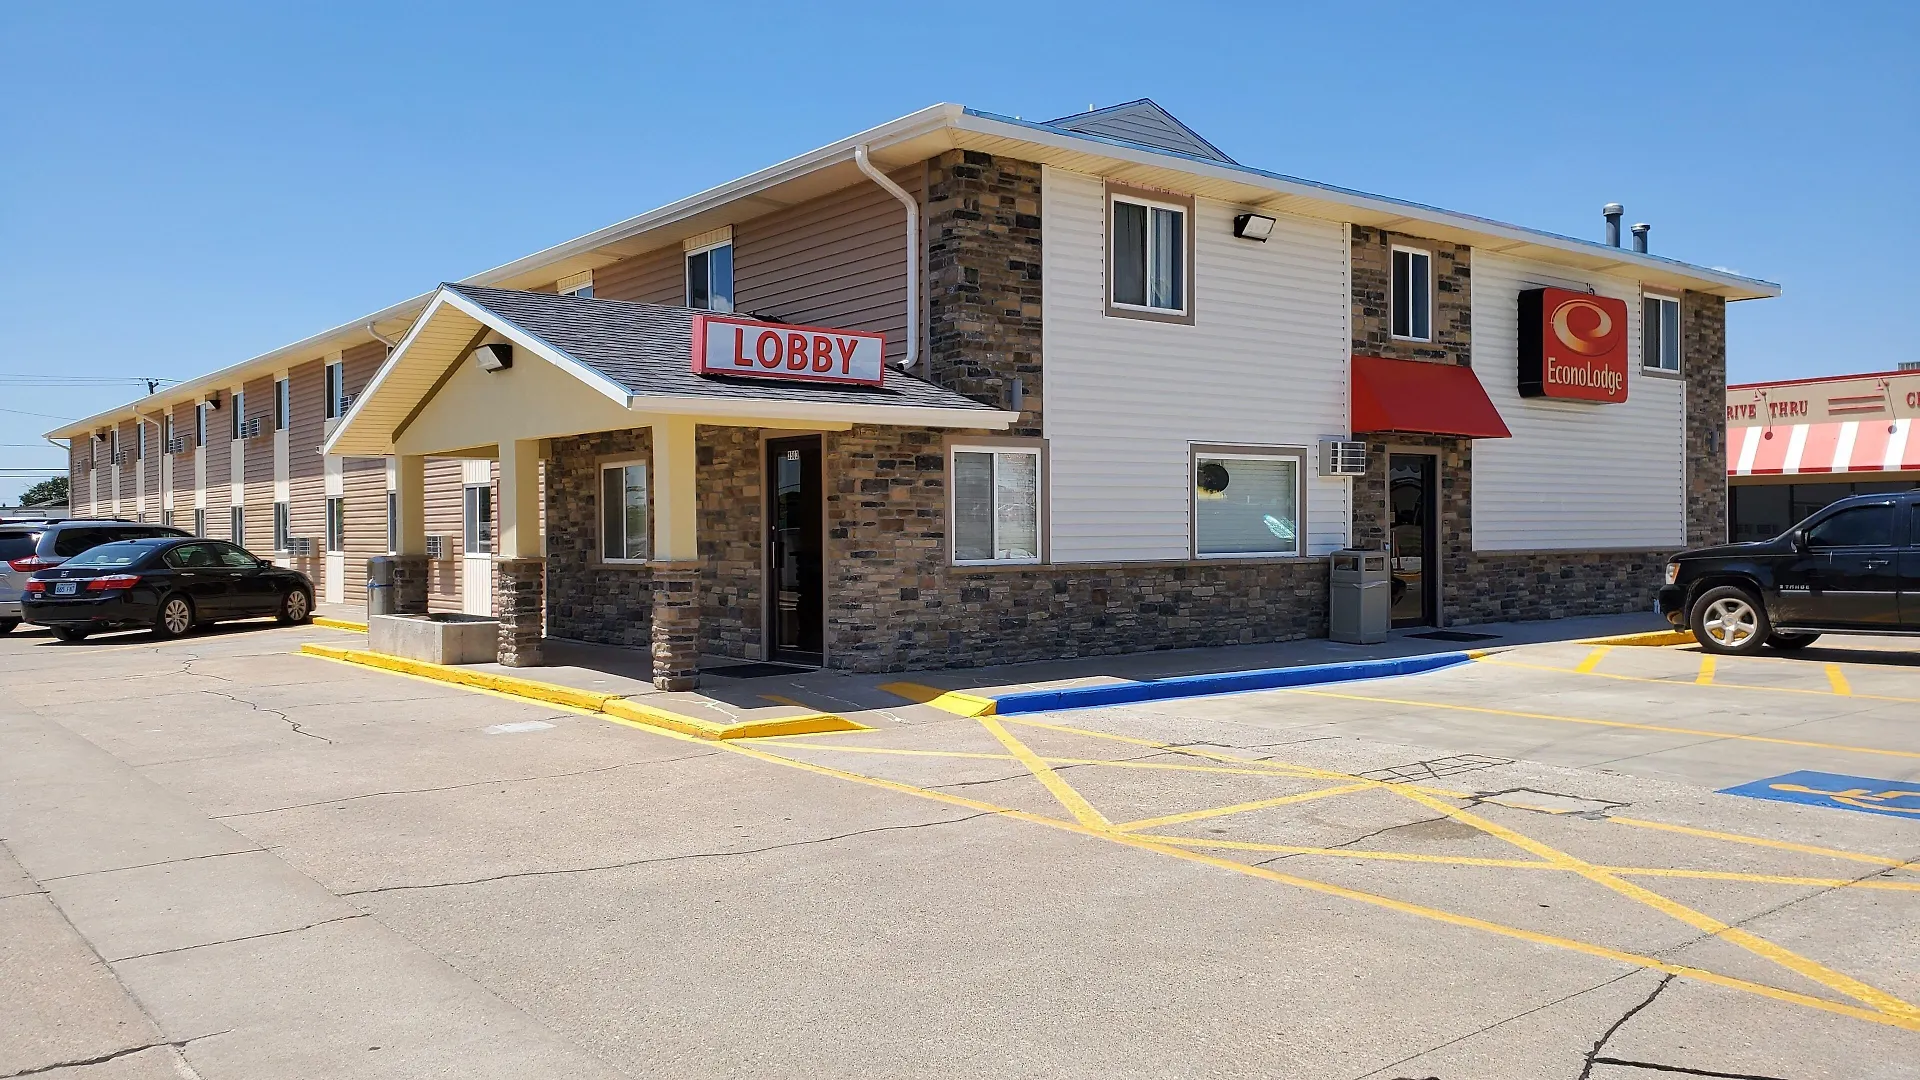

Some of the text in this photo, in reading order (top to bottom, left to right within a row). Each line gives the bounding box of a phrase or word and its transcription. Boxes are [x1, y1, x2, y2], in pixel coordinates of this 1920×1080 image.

[734, 327, 859, 375] LOBBY
[1547, 356, 1623, 396] EconoLodge
[1769, 400, 1809, 417] THRU
